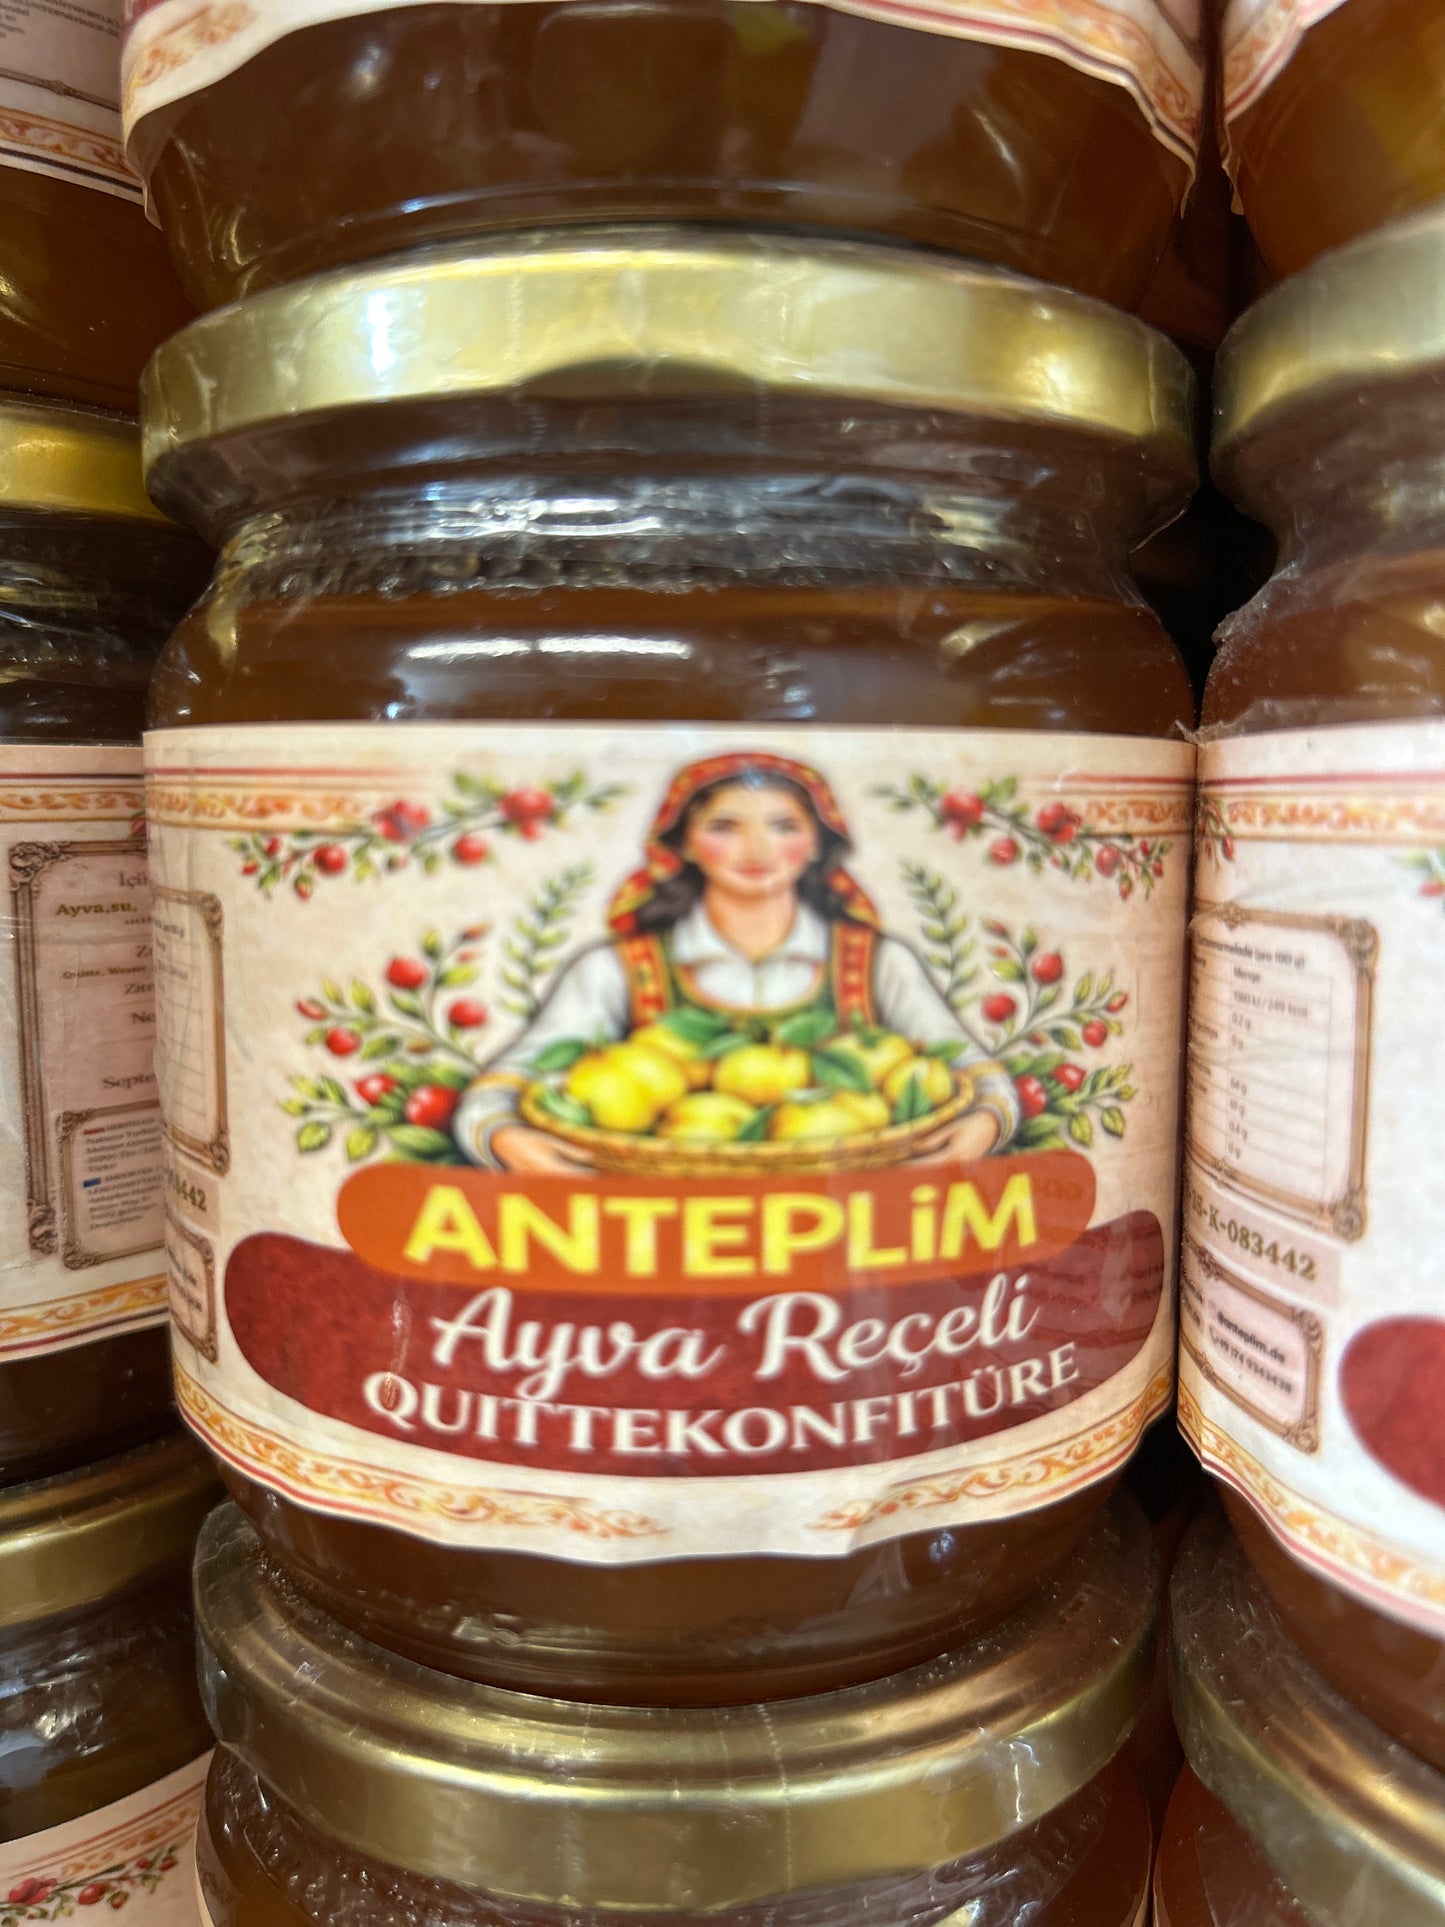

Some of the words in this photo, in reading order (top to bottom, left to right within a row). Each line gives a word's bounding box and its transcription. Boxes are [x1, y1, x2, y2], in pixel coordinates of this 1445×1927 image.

[429, 1286, 724, 1401] Ayva
[738, 1272, 1041, 1384] Reçeli
[361, 1341, 1080, 1457] QUITTEKONFITÜRE
